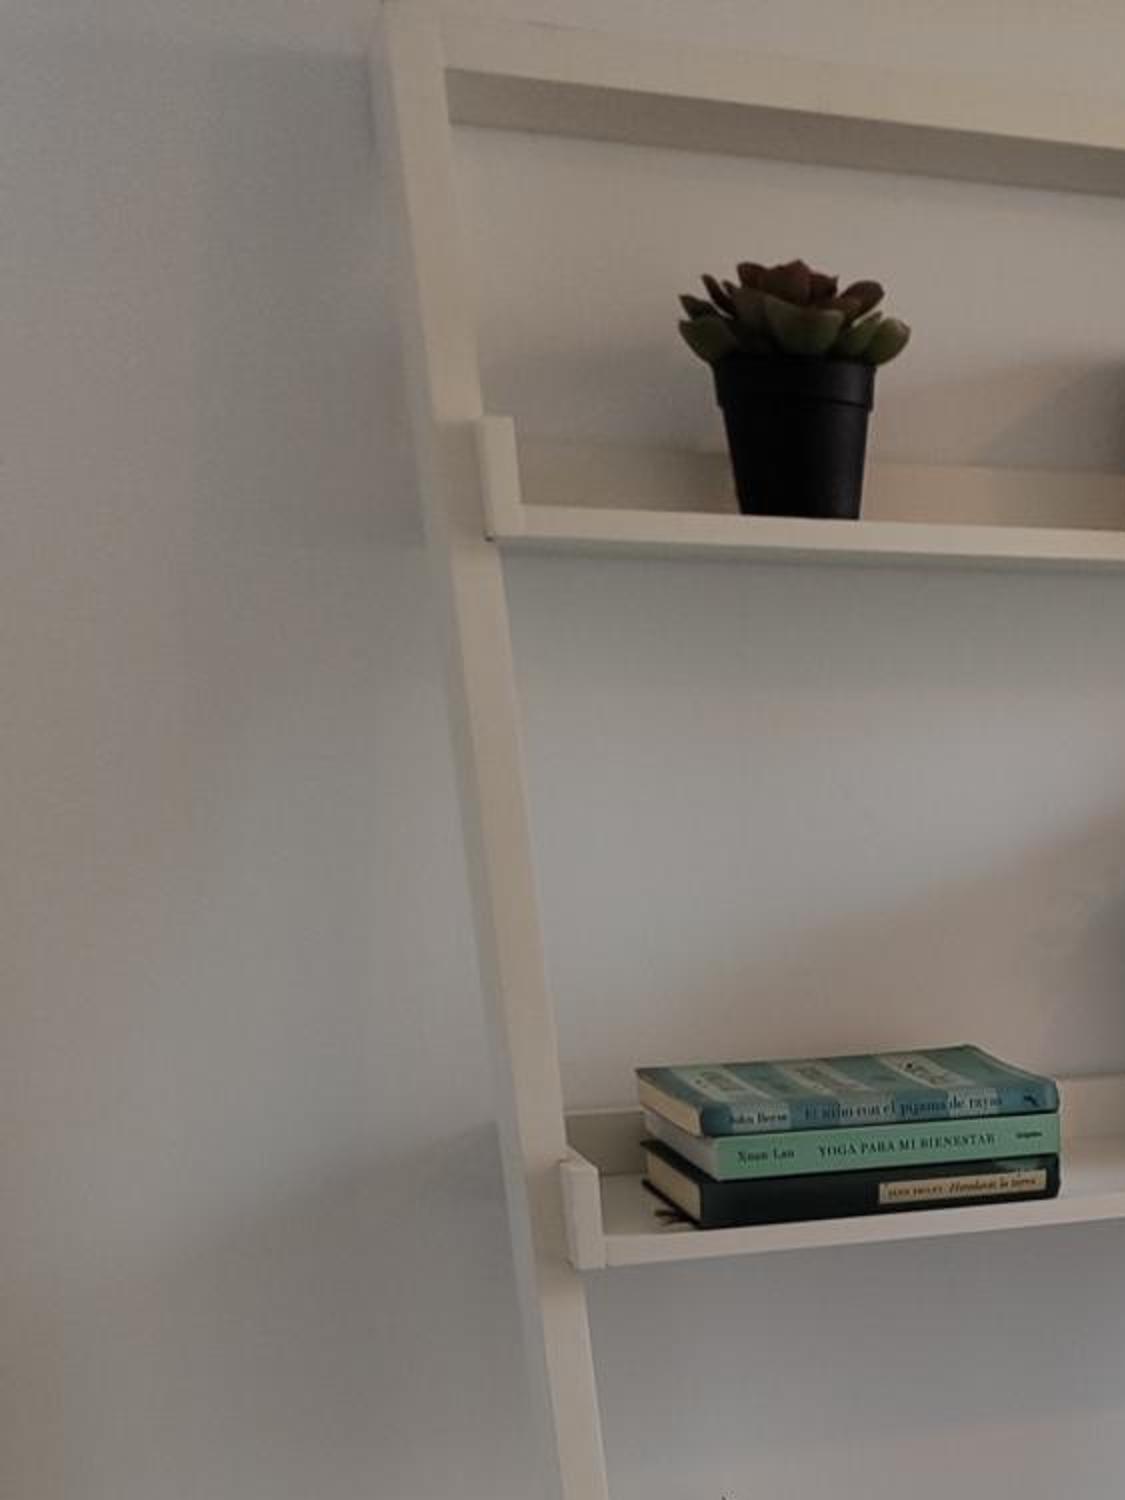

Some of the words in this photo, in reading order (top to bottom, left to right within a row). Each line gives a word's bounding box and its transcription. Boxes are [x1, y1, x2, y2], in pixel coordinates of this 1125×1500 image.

[883, 1099, 898, 1116] el
[949, 1095, 966, 1111] de
[817, 1142, 857, 1159] YOGA
[859, 1139, 896, 1156] PARA
[899, 1137, 917, 1152] MI
[919, 1133, 996, 1150] BIENESTAR
